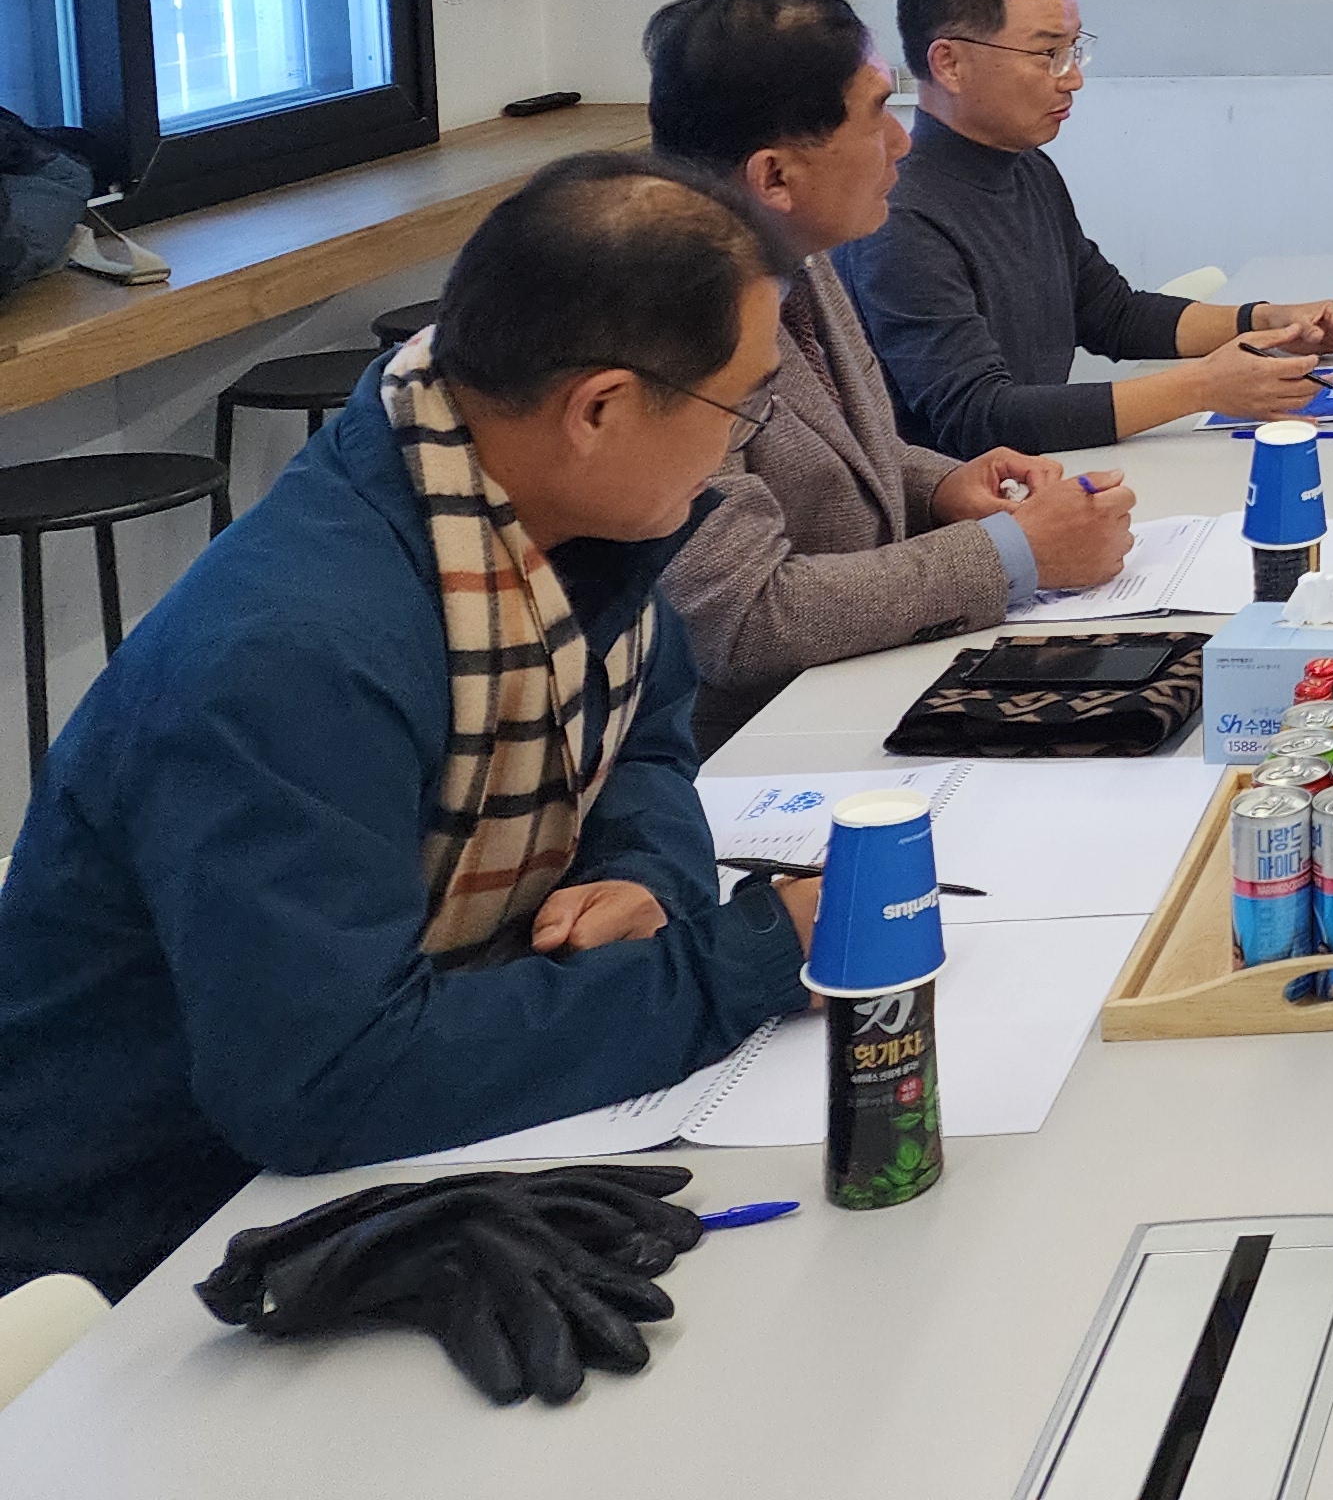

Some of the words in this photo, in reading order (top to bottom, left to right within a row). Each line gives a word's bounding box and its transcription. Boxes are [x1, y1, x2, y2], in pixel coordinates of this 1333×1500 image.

[1217, 714, 1242, 734] Sh
[1257, 821, 1303, 853] 나랑드
[854, 1030, 925, 1070] 헛개차
